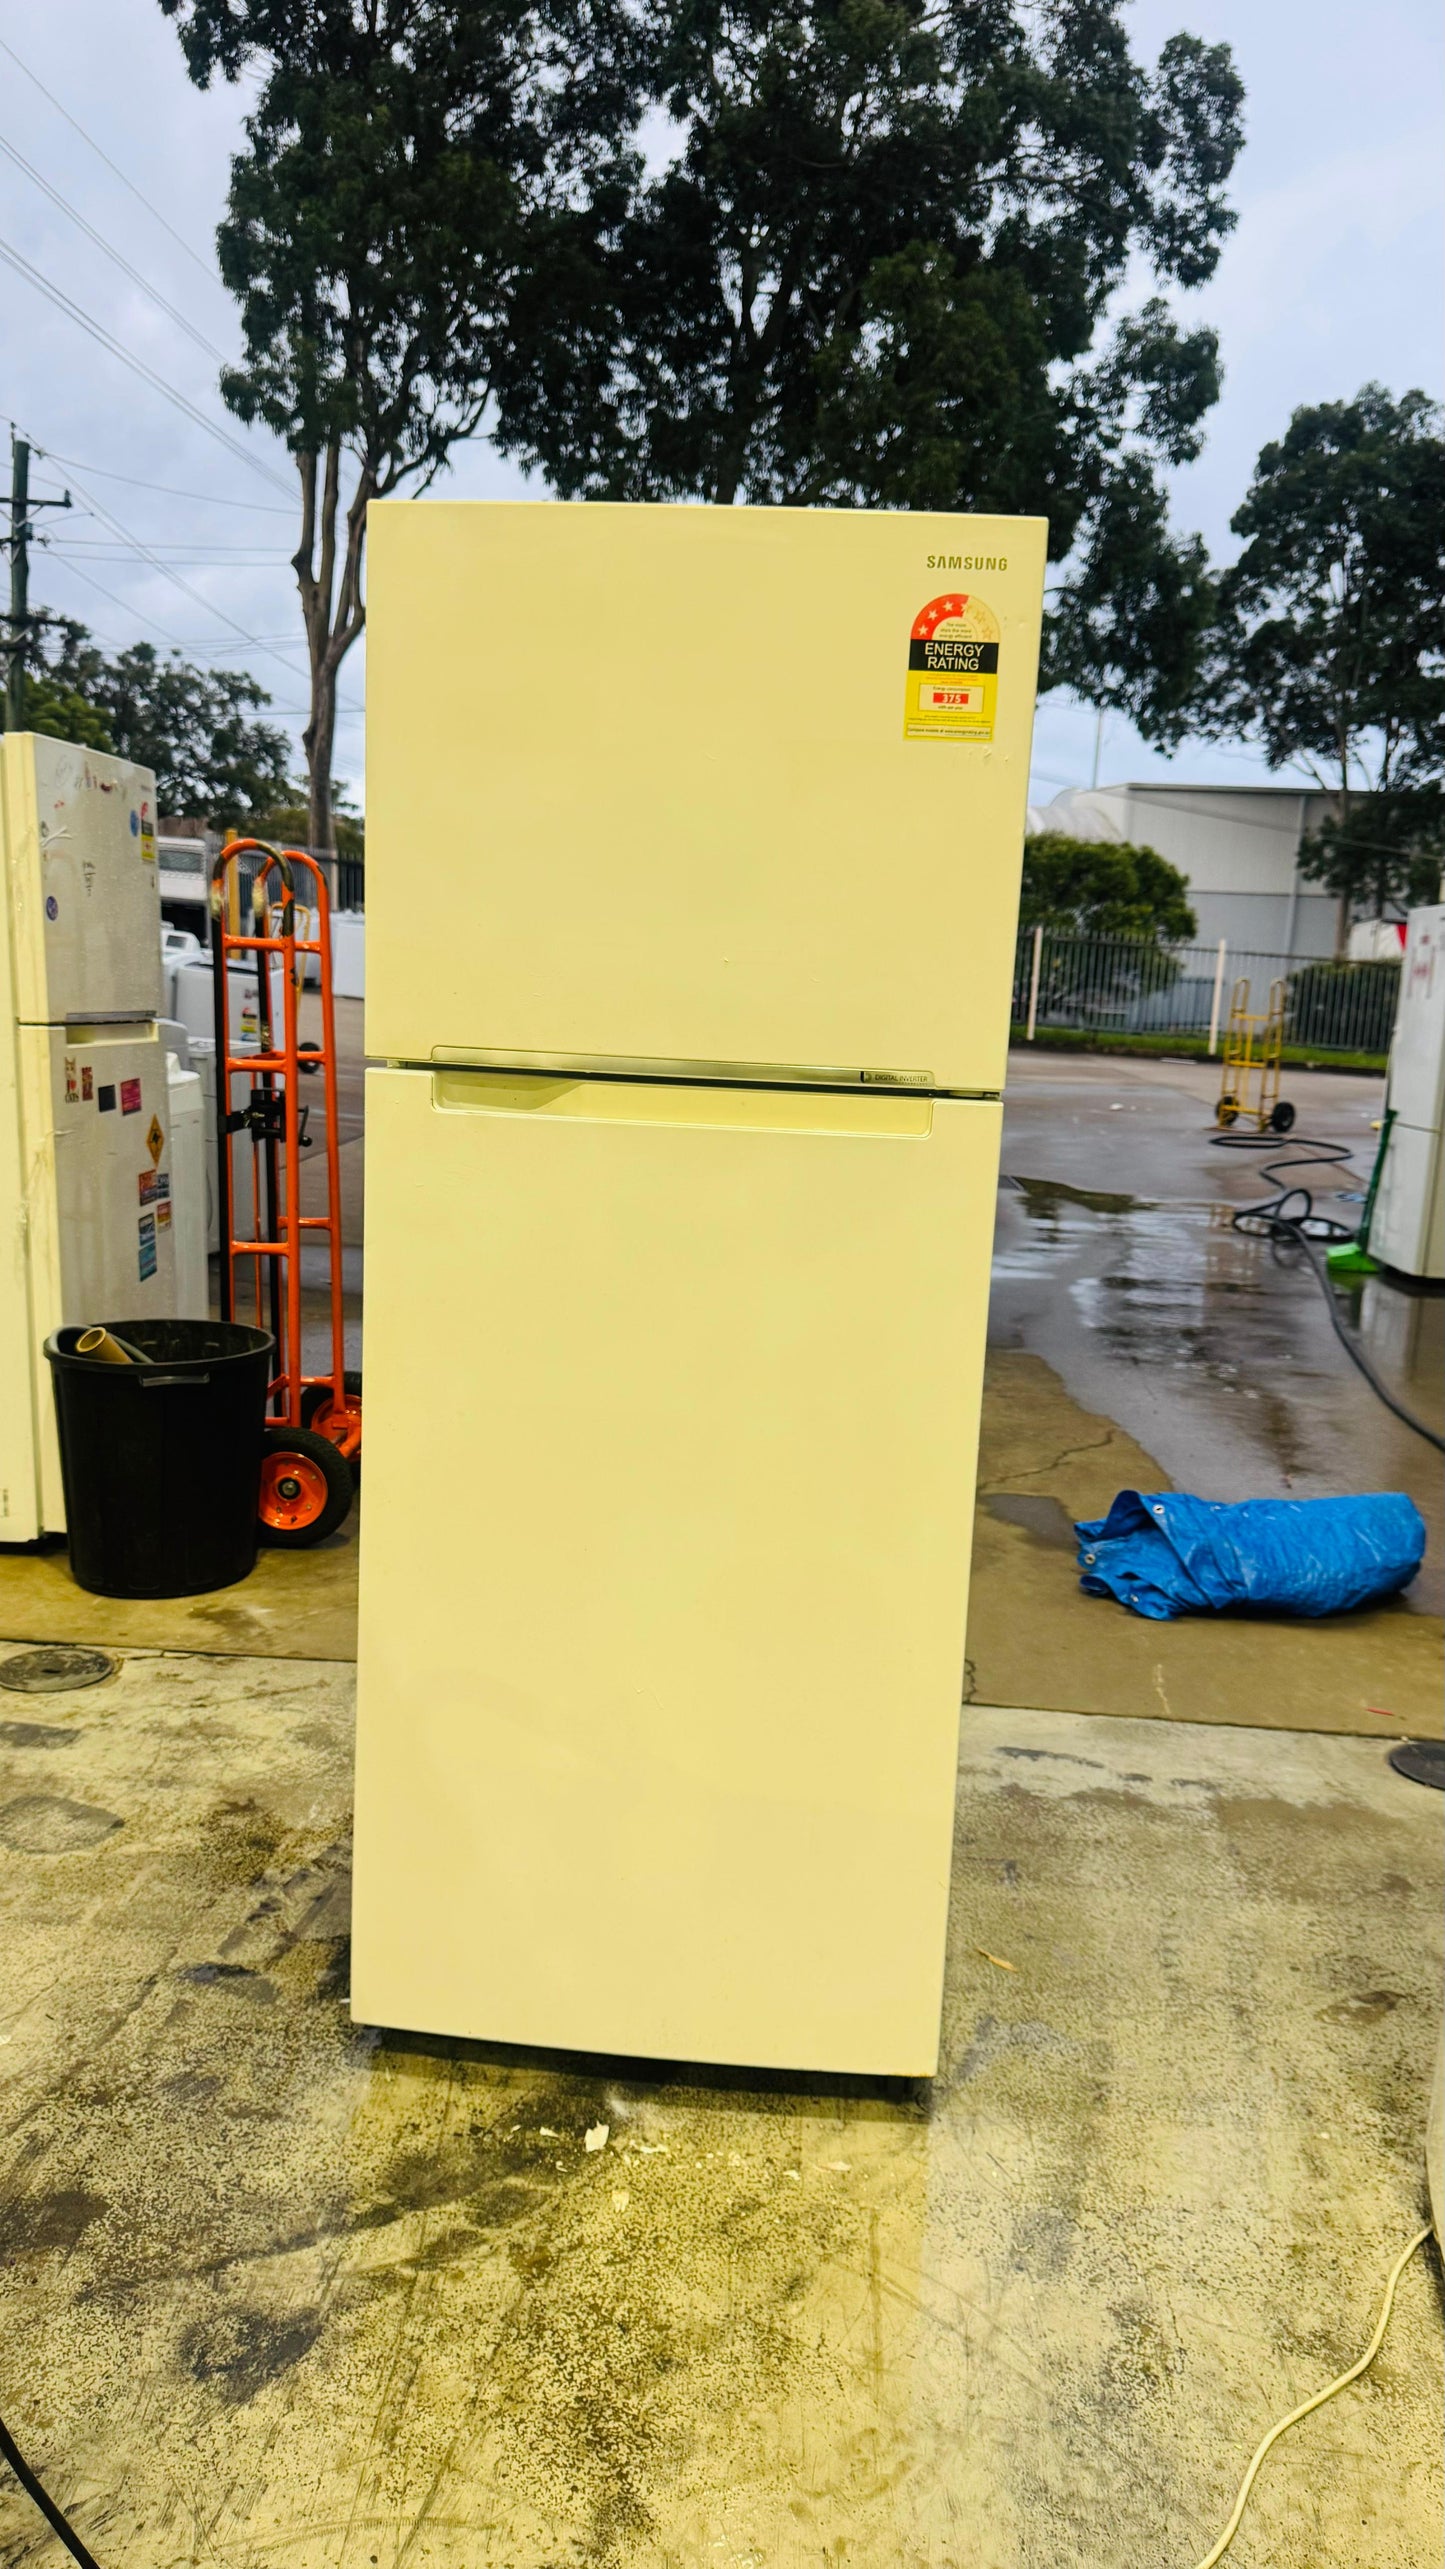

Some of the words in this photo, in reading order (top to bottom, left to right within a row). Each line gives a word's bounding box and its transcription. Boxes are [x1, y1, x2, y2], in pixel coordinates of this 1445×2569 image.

[926, 555, 1008, 571] SAMSUNG
[925, 642, 985, 657] ENERGY
[927, 656, 980, 671] RATING
[942, 694, 962, 704] 375
[874, 1074, 899, 1082] DIGITAL
